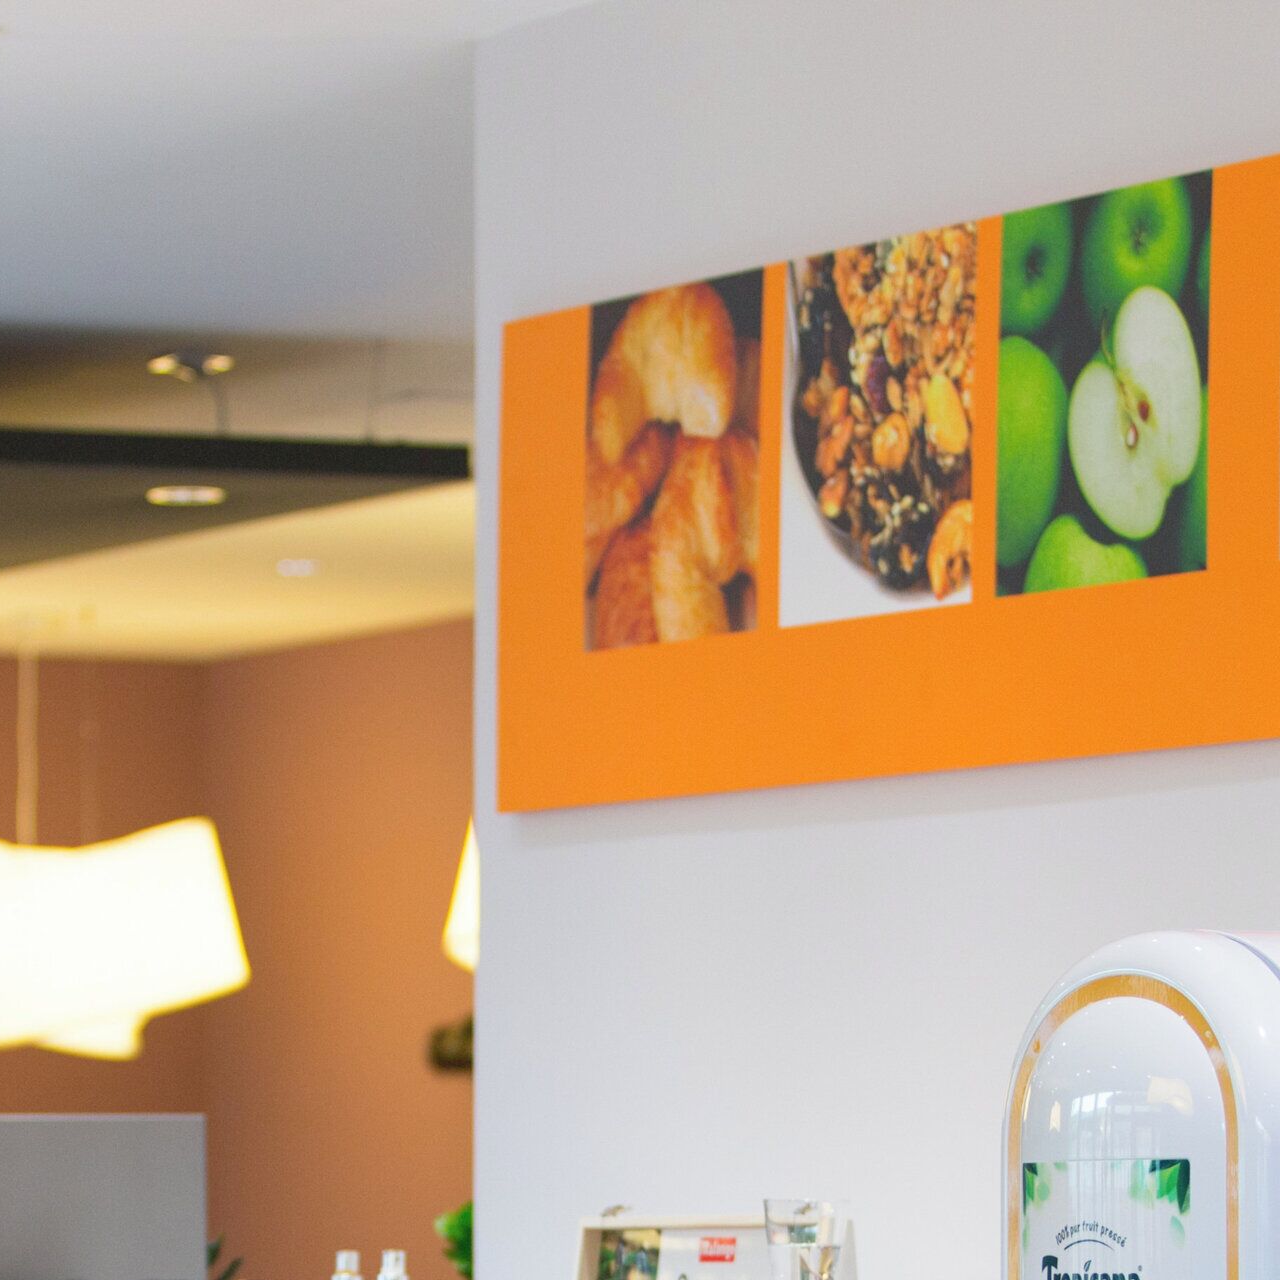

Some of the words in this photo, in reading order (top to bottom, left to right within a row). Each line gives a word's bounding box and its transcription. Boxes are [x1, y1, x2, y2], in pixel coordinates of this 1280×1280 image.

[1070, 1223, 1081, 1238] pur
[1082, 1221, 1099, 1232] fruit
[1100, 1224, 1127, 1248] pressé
